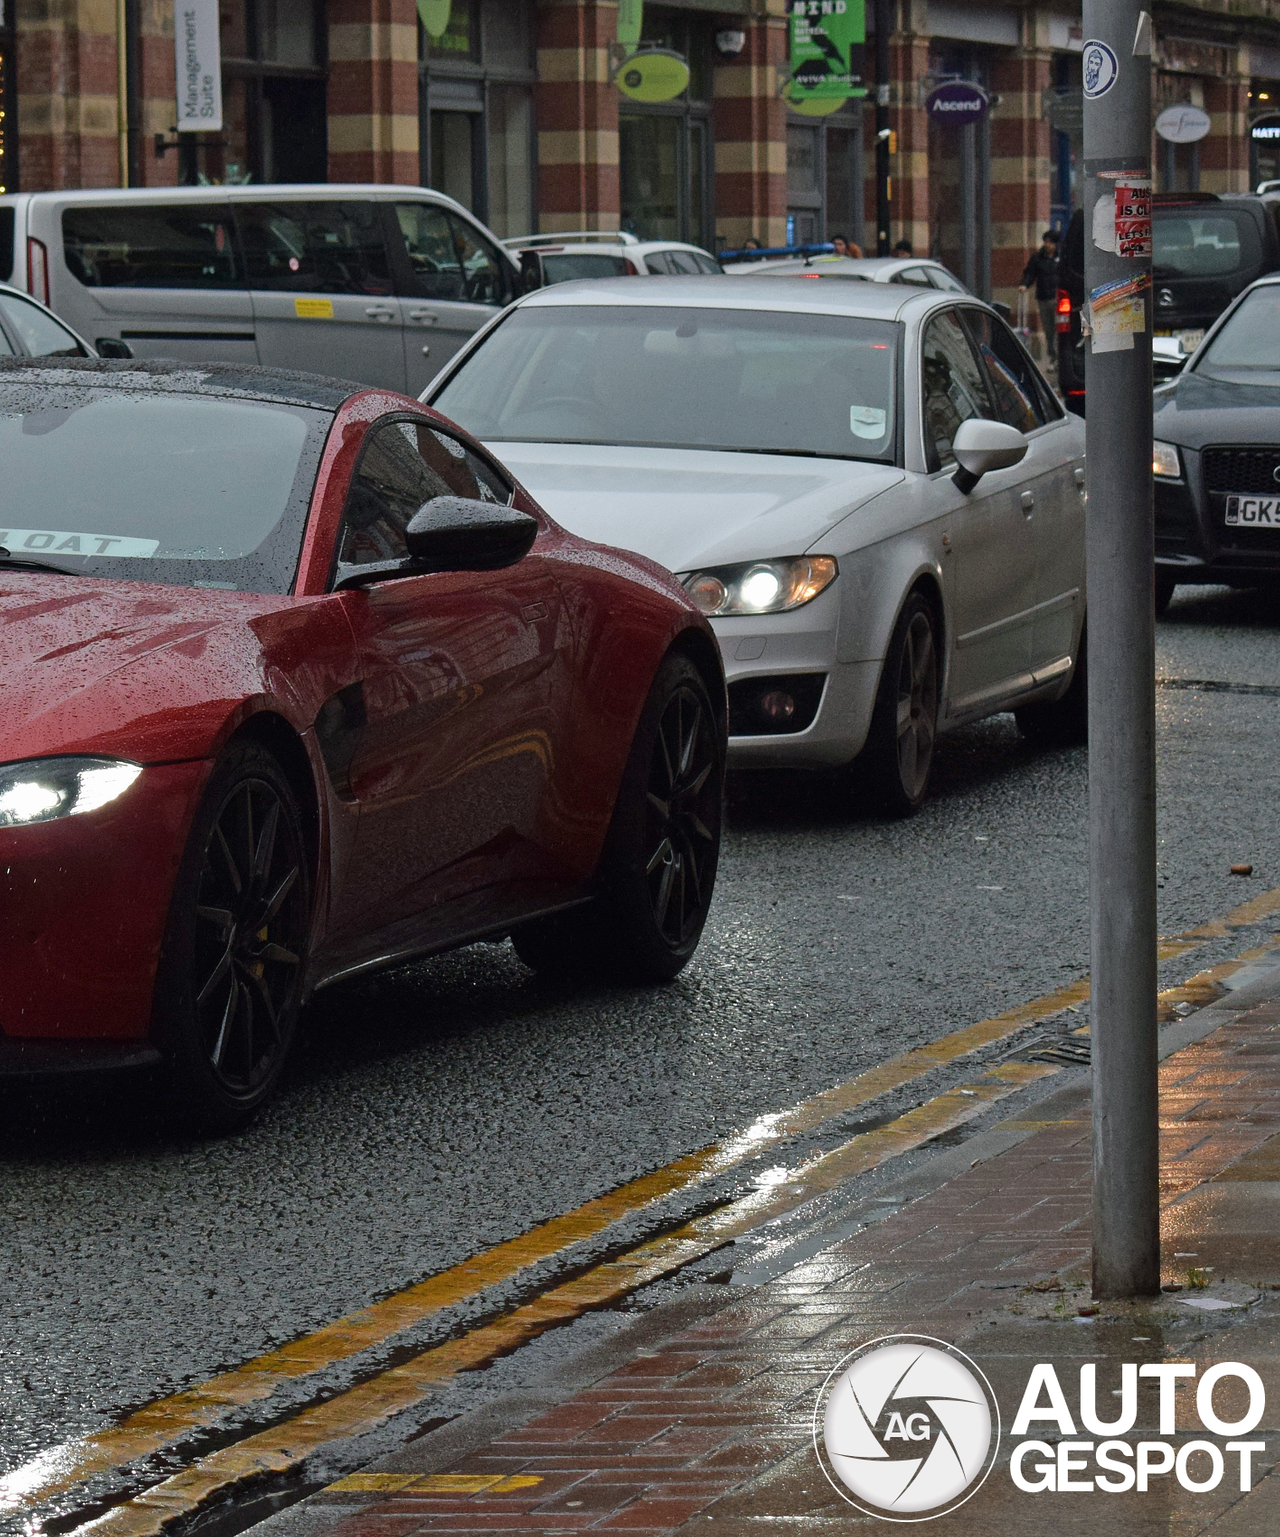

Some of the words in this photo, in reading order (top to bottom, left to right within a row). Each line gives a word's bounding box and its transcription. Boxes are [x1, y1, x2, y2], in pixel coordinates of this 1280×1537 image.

[793, 1, 847, 15] MIND
[184, 8, 201, 118] Management
[201, 75, 215, 118] Suite
[932, 99, 982, 112] Ascend
[1121, 205, 1133, 216] IS
[1136, 205, 1151, 216] CL
[22, 533, 122, 555] OAT
